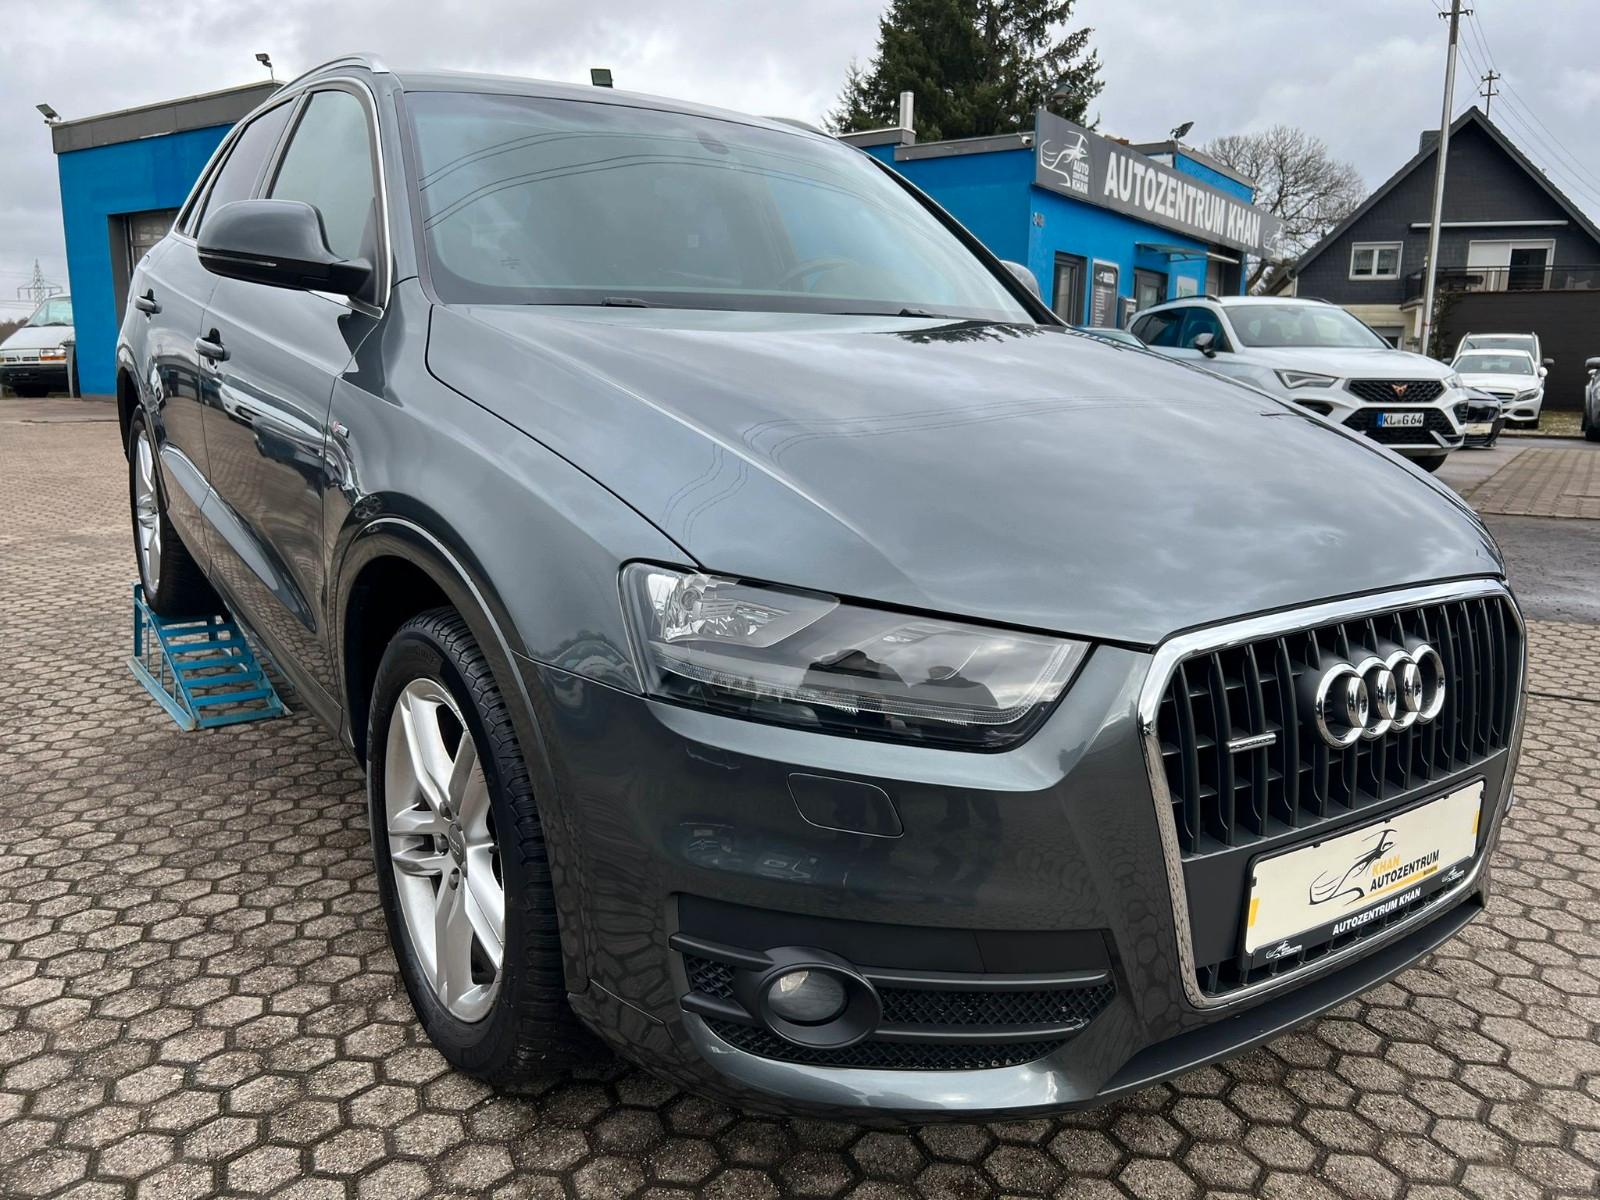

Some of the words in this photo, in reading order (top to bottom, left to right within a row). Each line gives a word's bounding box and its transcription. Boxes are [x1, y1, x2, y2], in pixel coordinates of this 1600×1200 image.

[1104, 151, 1225, 235] AUTOZENTRUM
[1226, 201, 1261, 249] KHAN
[1370, 849, 1440, 892] AUTOZENTRUM
[1371, 854, 1401, 876] KHAN
[1332, 900, 1398, 935] AUTOZENTRUM
[1399, 888, 1421, 910] KHAN
